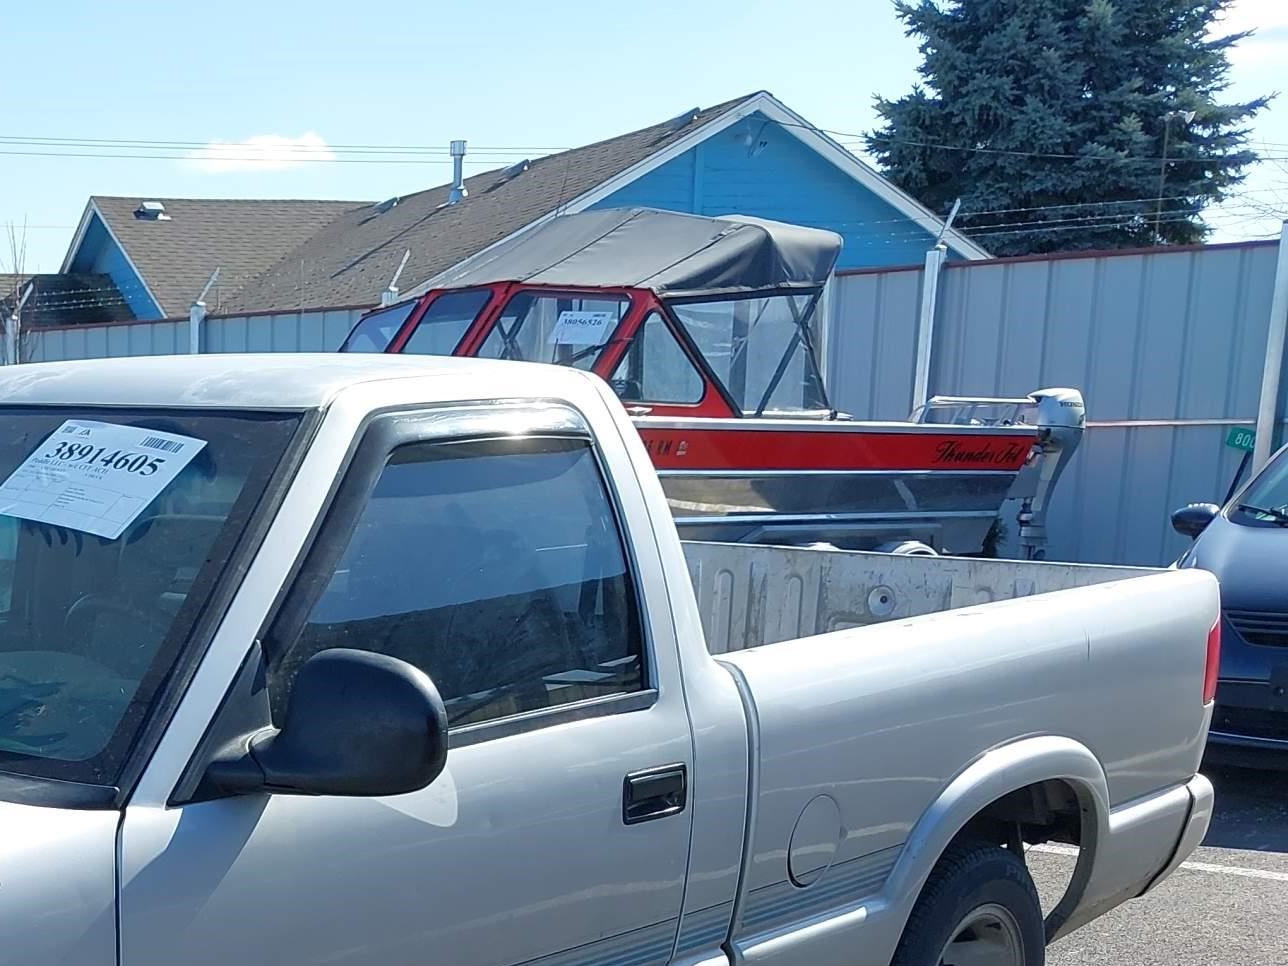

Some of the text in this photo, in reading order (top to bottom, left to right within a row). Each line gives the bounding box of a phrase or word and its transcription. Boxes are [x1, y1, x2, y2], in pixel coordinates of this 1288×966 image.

[45, 441, 166, 477] 38914605
[932, 440, 1025, 464] Thunder Jet
